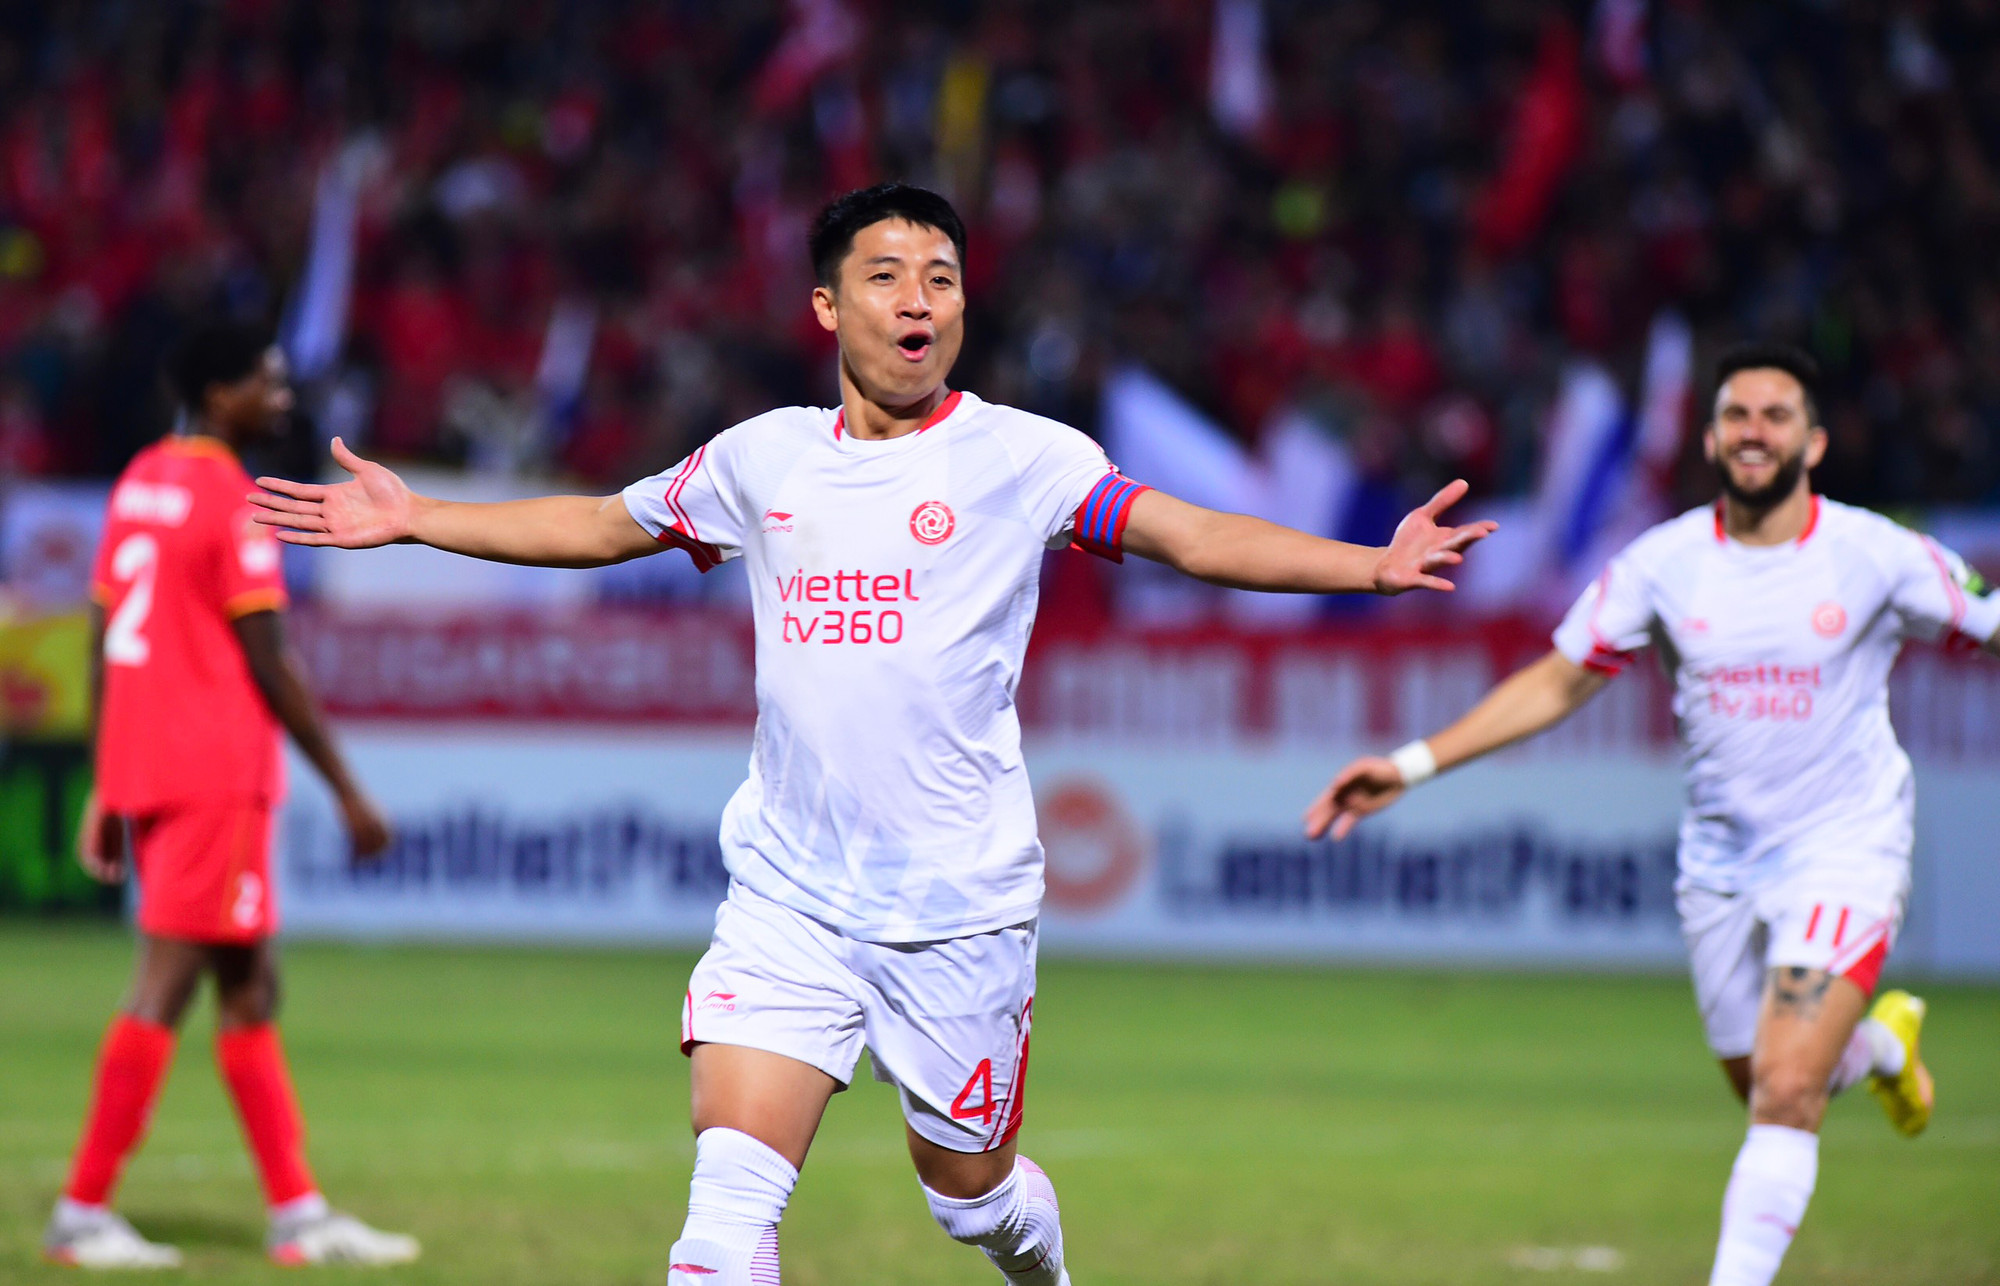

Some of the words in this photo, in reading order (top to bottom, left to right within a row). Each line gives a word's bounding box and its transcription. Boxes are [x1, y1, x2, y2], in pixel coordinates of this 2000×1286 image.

[103, 531, 158, 668] 2
[776, 568, 920, 602] viettel
[782, 610, 903, 644] tv360
[1804, 903, 1851, 948] 11
[950, 1057, 998, 1126] 4
